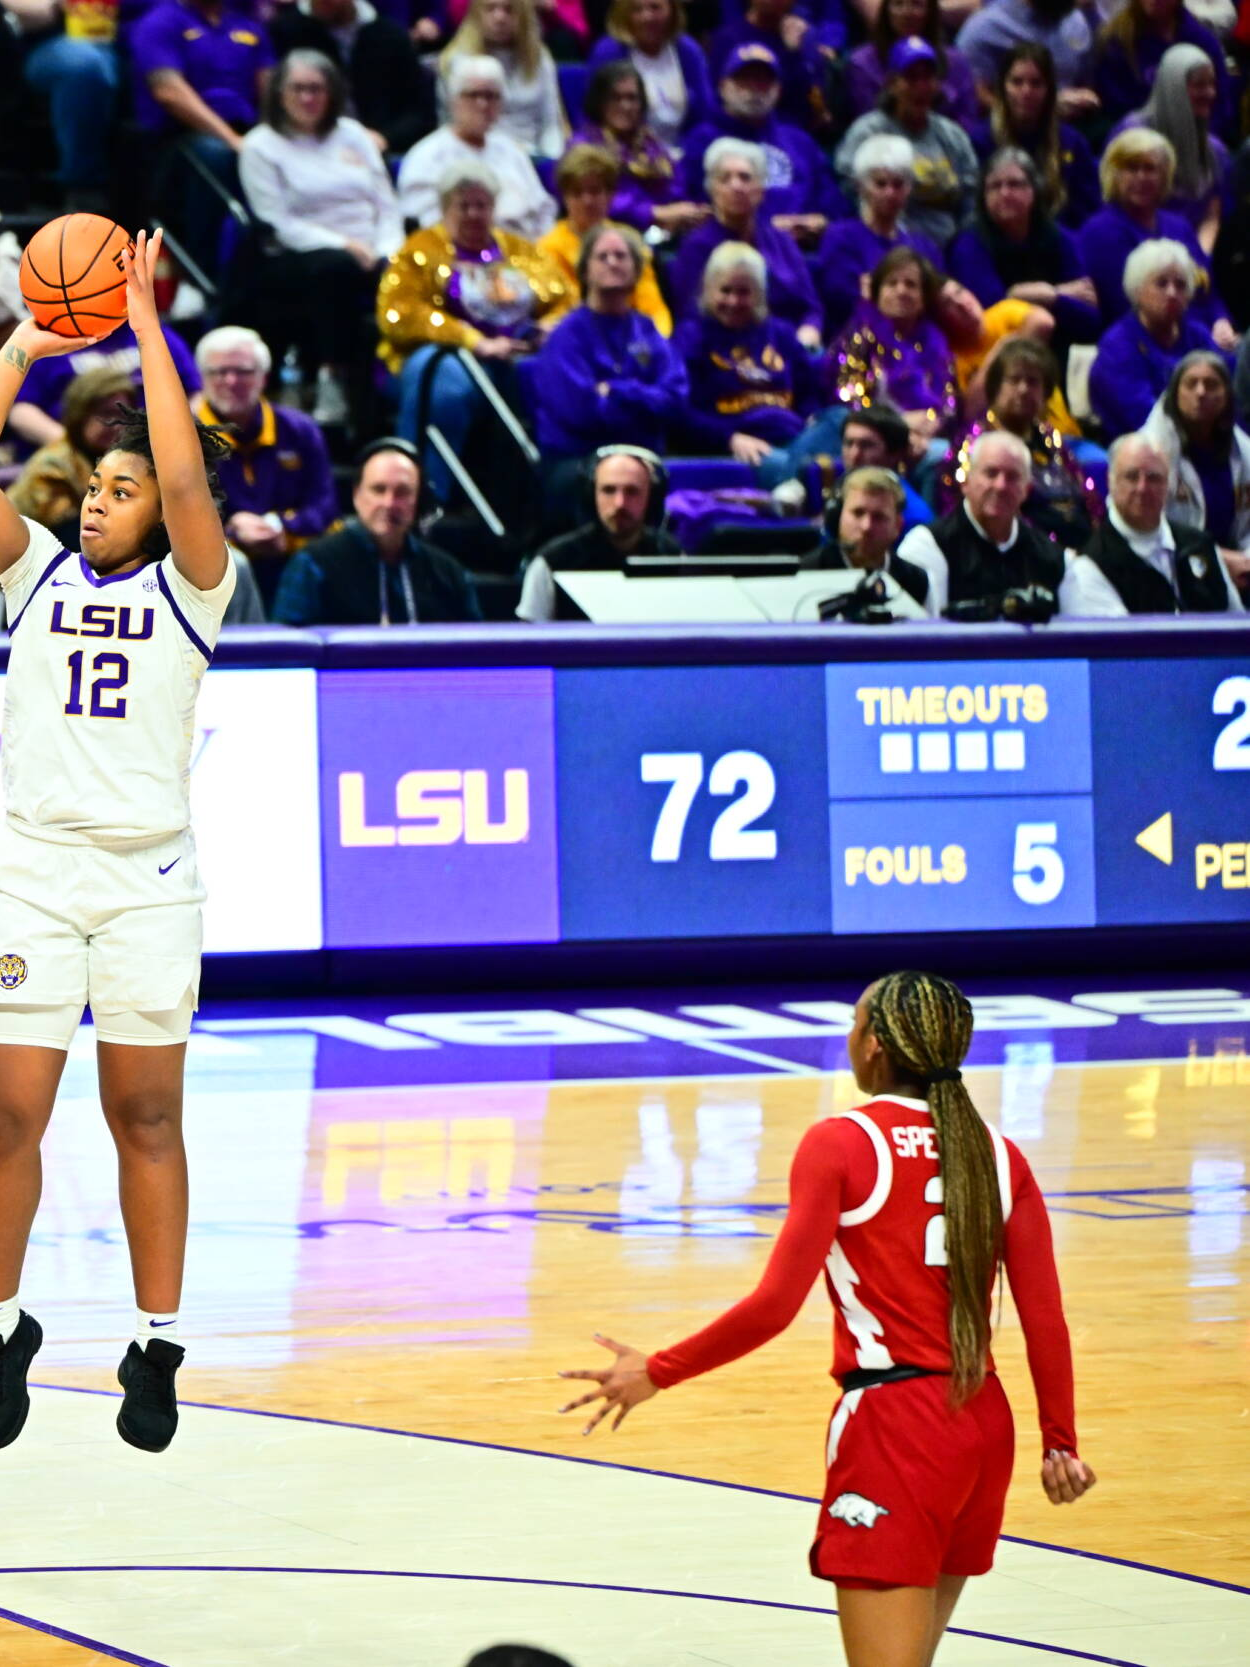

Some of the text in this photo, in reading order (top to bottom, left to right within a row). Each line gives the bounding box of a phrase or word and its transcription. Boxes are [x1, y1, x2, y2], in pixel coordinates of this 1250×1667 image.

[50, 601, 155, 641] LSU
[63, 649, 129, 720] 12
[856, 684, 1048, 726] TIMEOUTS
[339, 768, 529, 847] LSU
[640, 750, 777, 862] 72
[844, 844, 967, 887] FOULS
[1012, 822, 1065, 905] 5
[1195, 842, 1250, 890] PE
